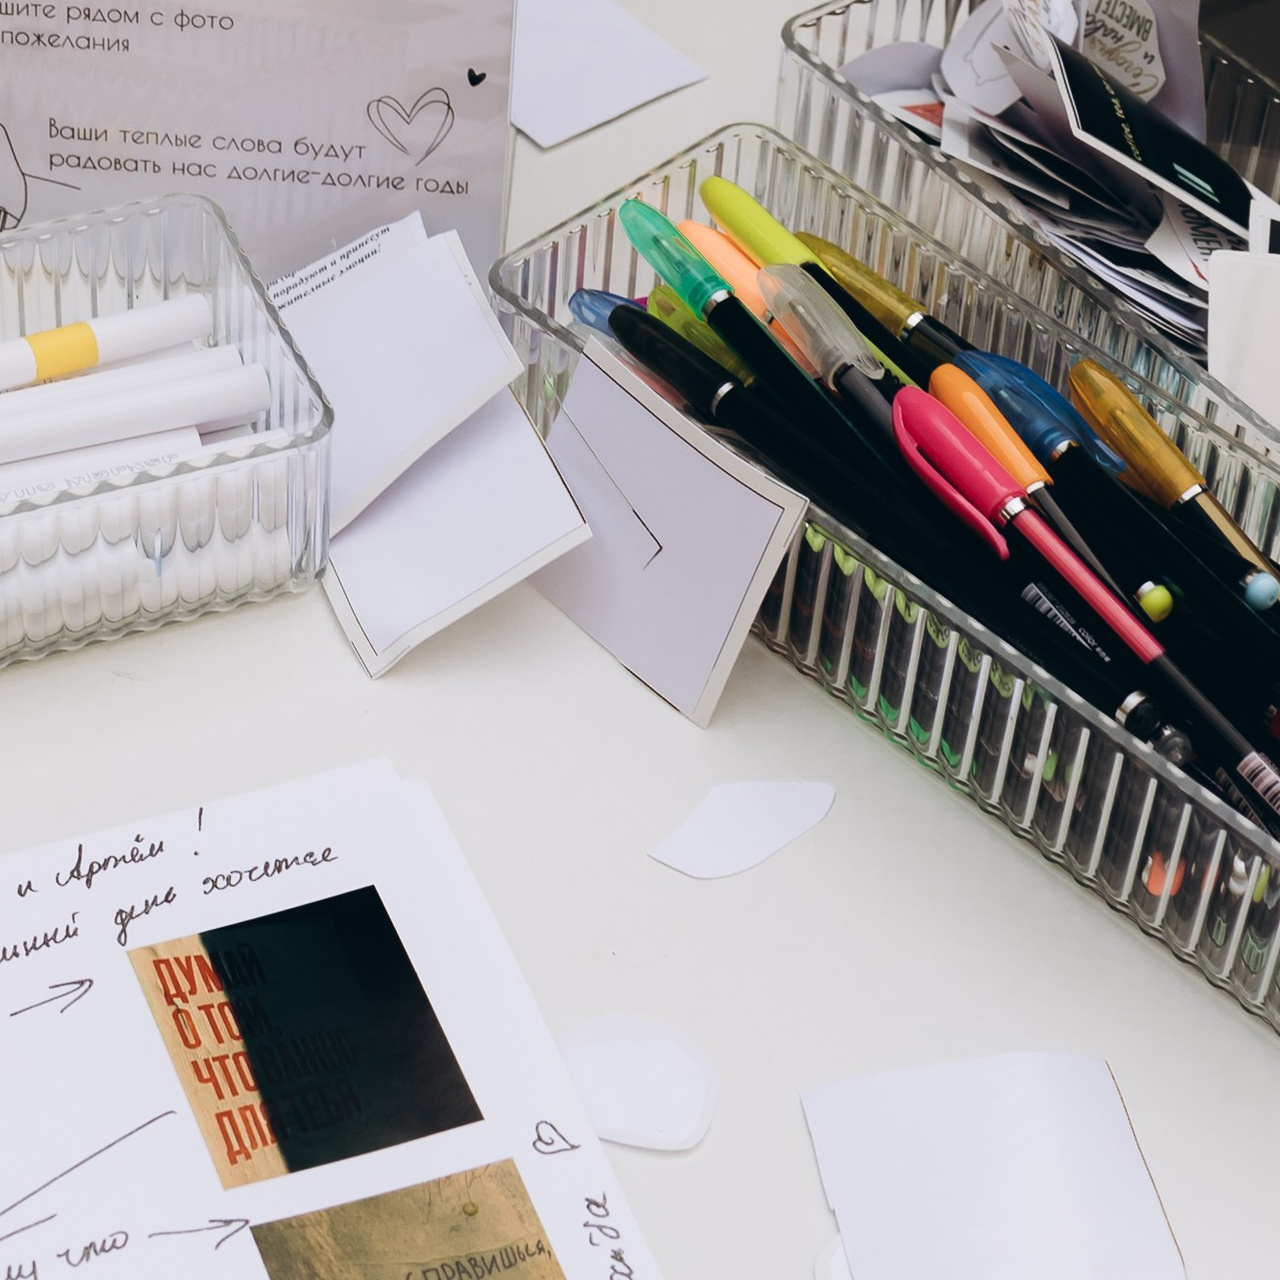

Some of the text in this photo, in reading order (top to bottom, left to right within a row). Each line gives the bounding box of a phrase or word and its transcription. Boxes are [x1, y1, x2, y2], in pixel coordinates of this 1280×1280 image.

[66, 2, 139, 28] рядом
[150, 10, 164, 26] с
[174, 5, 234, 33] фото
[1, 28, 131, 53] пожелания
[48, 117, 366, 160] Ваши теплые слова будут
[48, 150, 470, 196] радовать нас долгие-долгие годы
[17, 879, 38, 899] и
[113, 885, 176, 947] день
[172, 1008, 202, 1050] О
[192, 1050, 259, 1100] ЧТО
[56, 1230, 130, 1268] что
